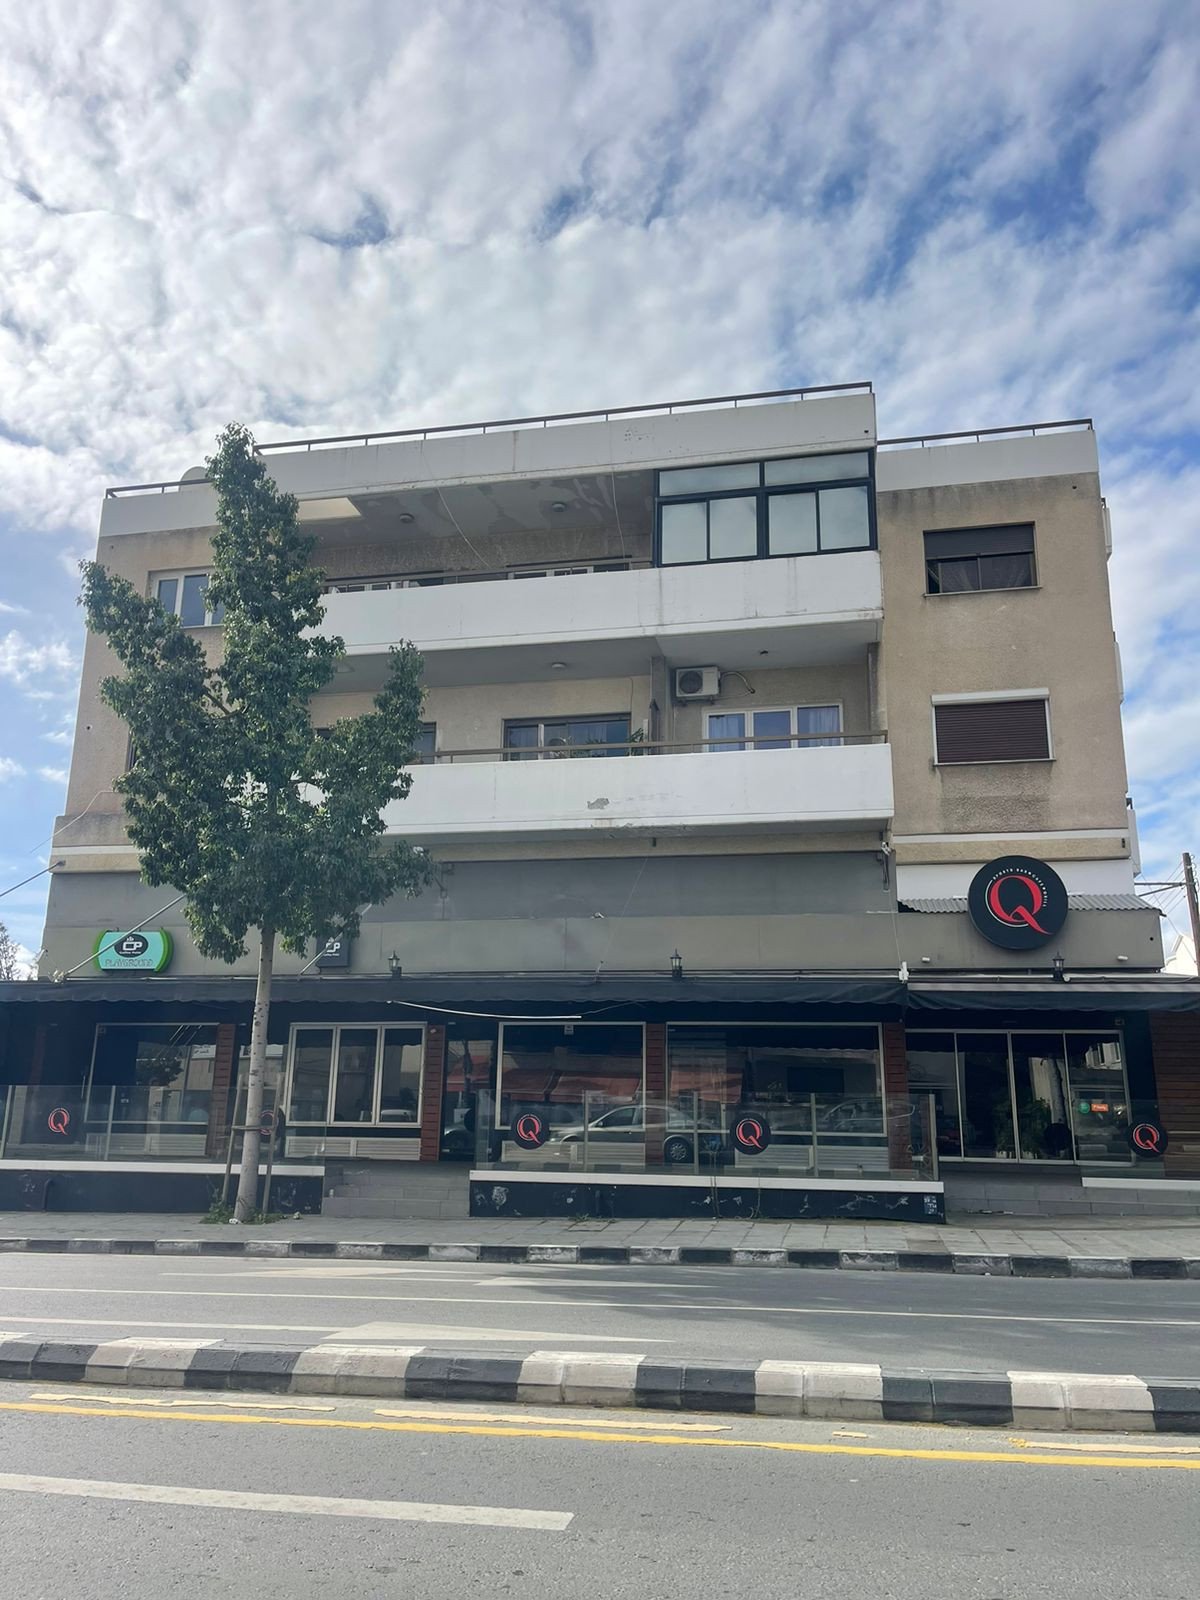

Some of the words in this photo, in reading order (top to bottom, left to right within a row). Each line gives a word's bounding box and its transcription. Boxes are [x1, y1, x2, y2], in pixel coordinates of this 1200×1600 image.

[990, 874, 1054, 935] Q
[50, 1110, 68, 1136] Q
[518, 1116, 541, 1145] Q
[738, 1120, 764, 1149] Q
[1135, 1126, 1159, 1153] Q
